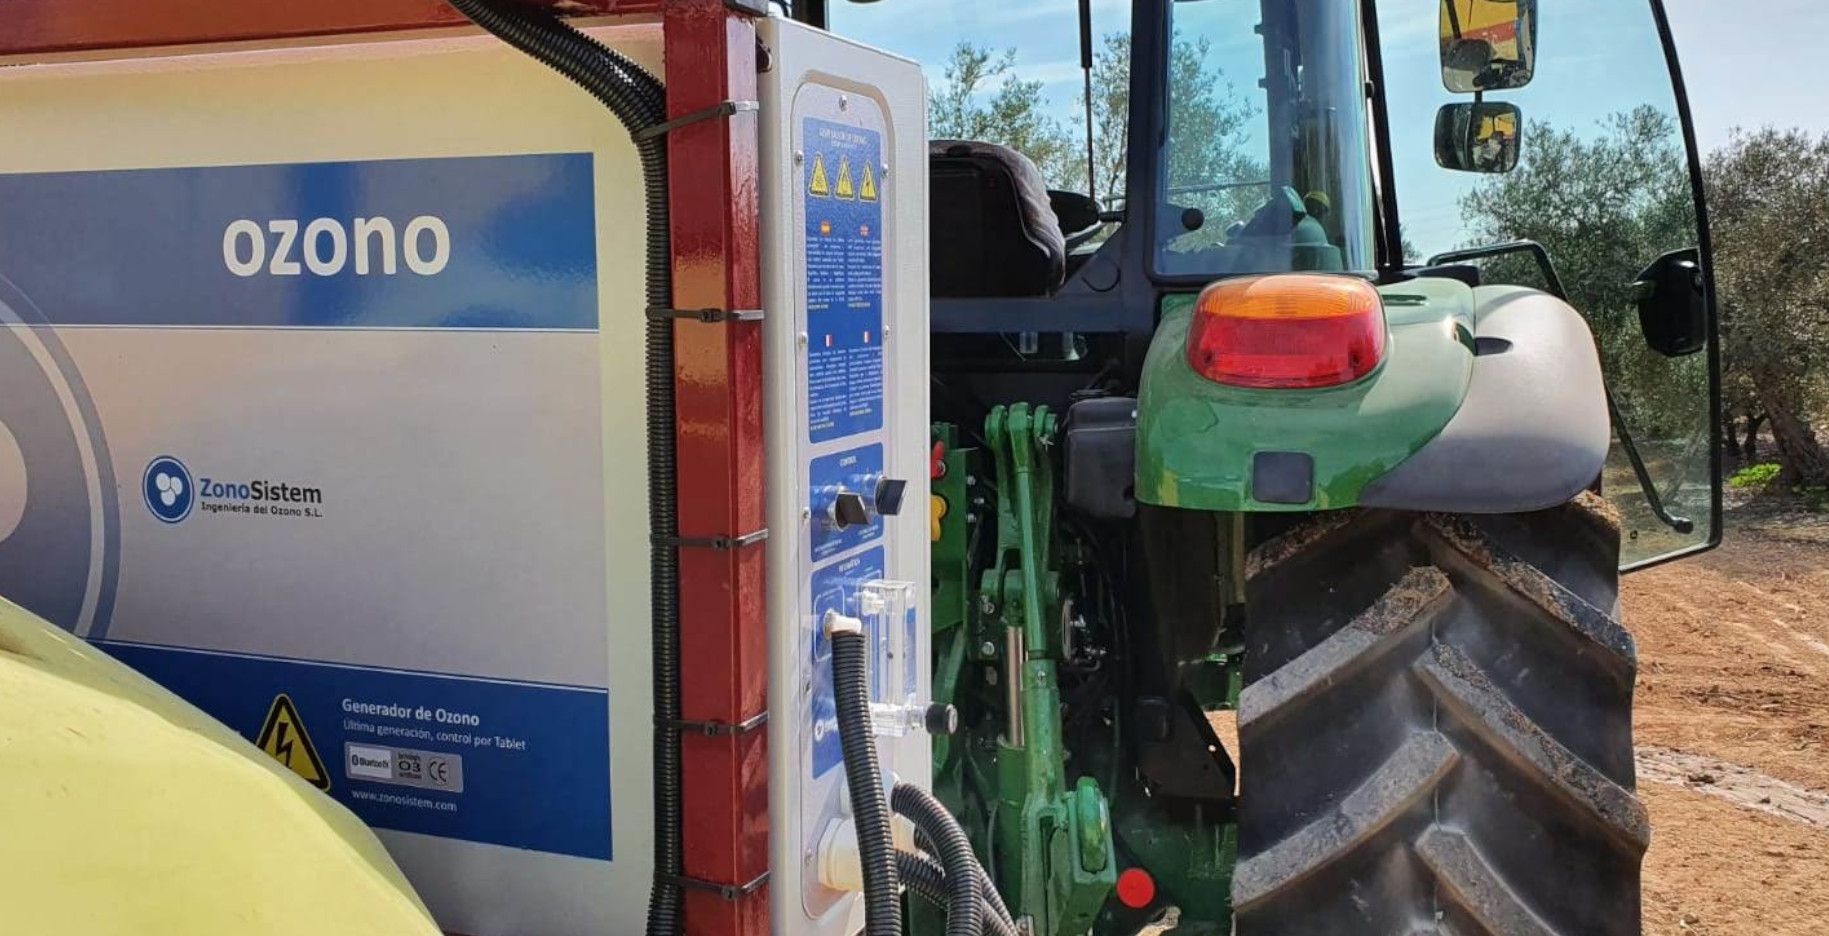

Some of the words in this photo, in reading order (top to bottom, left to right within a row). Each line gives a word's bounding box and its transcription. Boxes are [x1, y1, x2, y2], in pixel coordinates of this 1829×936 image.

[223, 215, 450, 277] ozono
[200, 478, 322, 503] ZonoSistem
[253, 505, 268, 514] del
[271, 505, 301, 516] Ozono
[304, 507, 323, 518] S.L.
[342, 698, 411, 718] Generador
[415, 706, 431, 721] de
[435, 708, 480, 726] Ozono
[436, 731, 471, 745] control
[474, 736, 491, 747] por
[494, 736, 526, 750] Tablet
[351, 789, 458, 812] www.zonosistem.com
